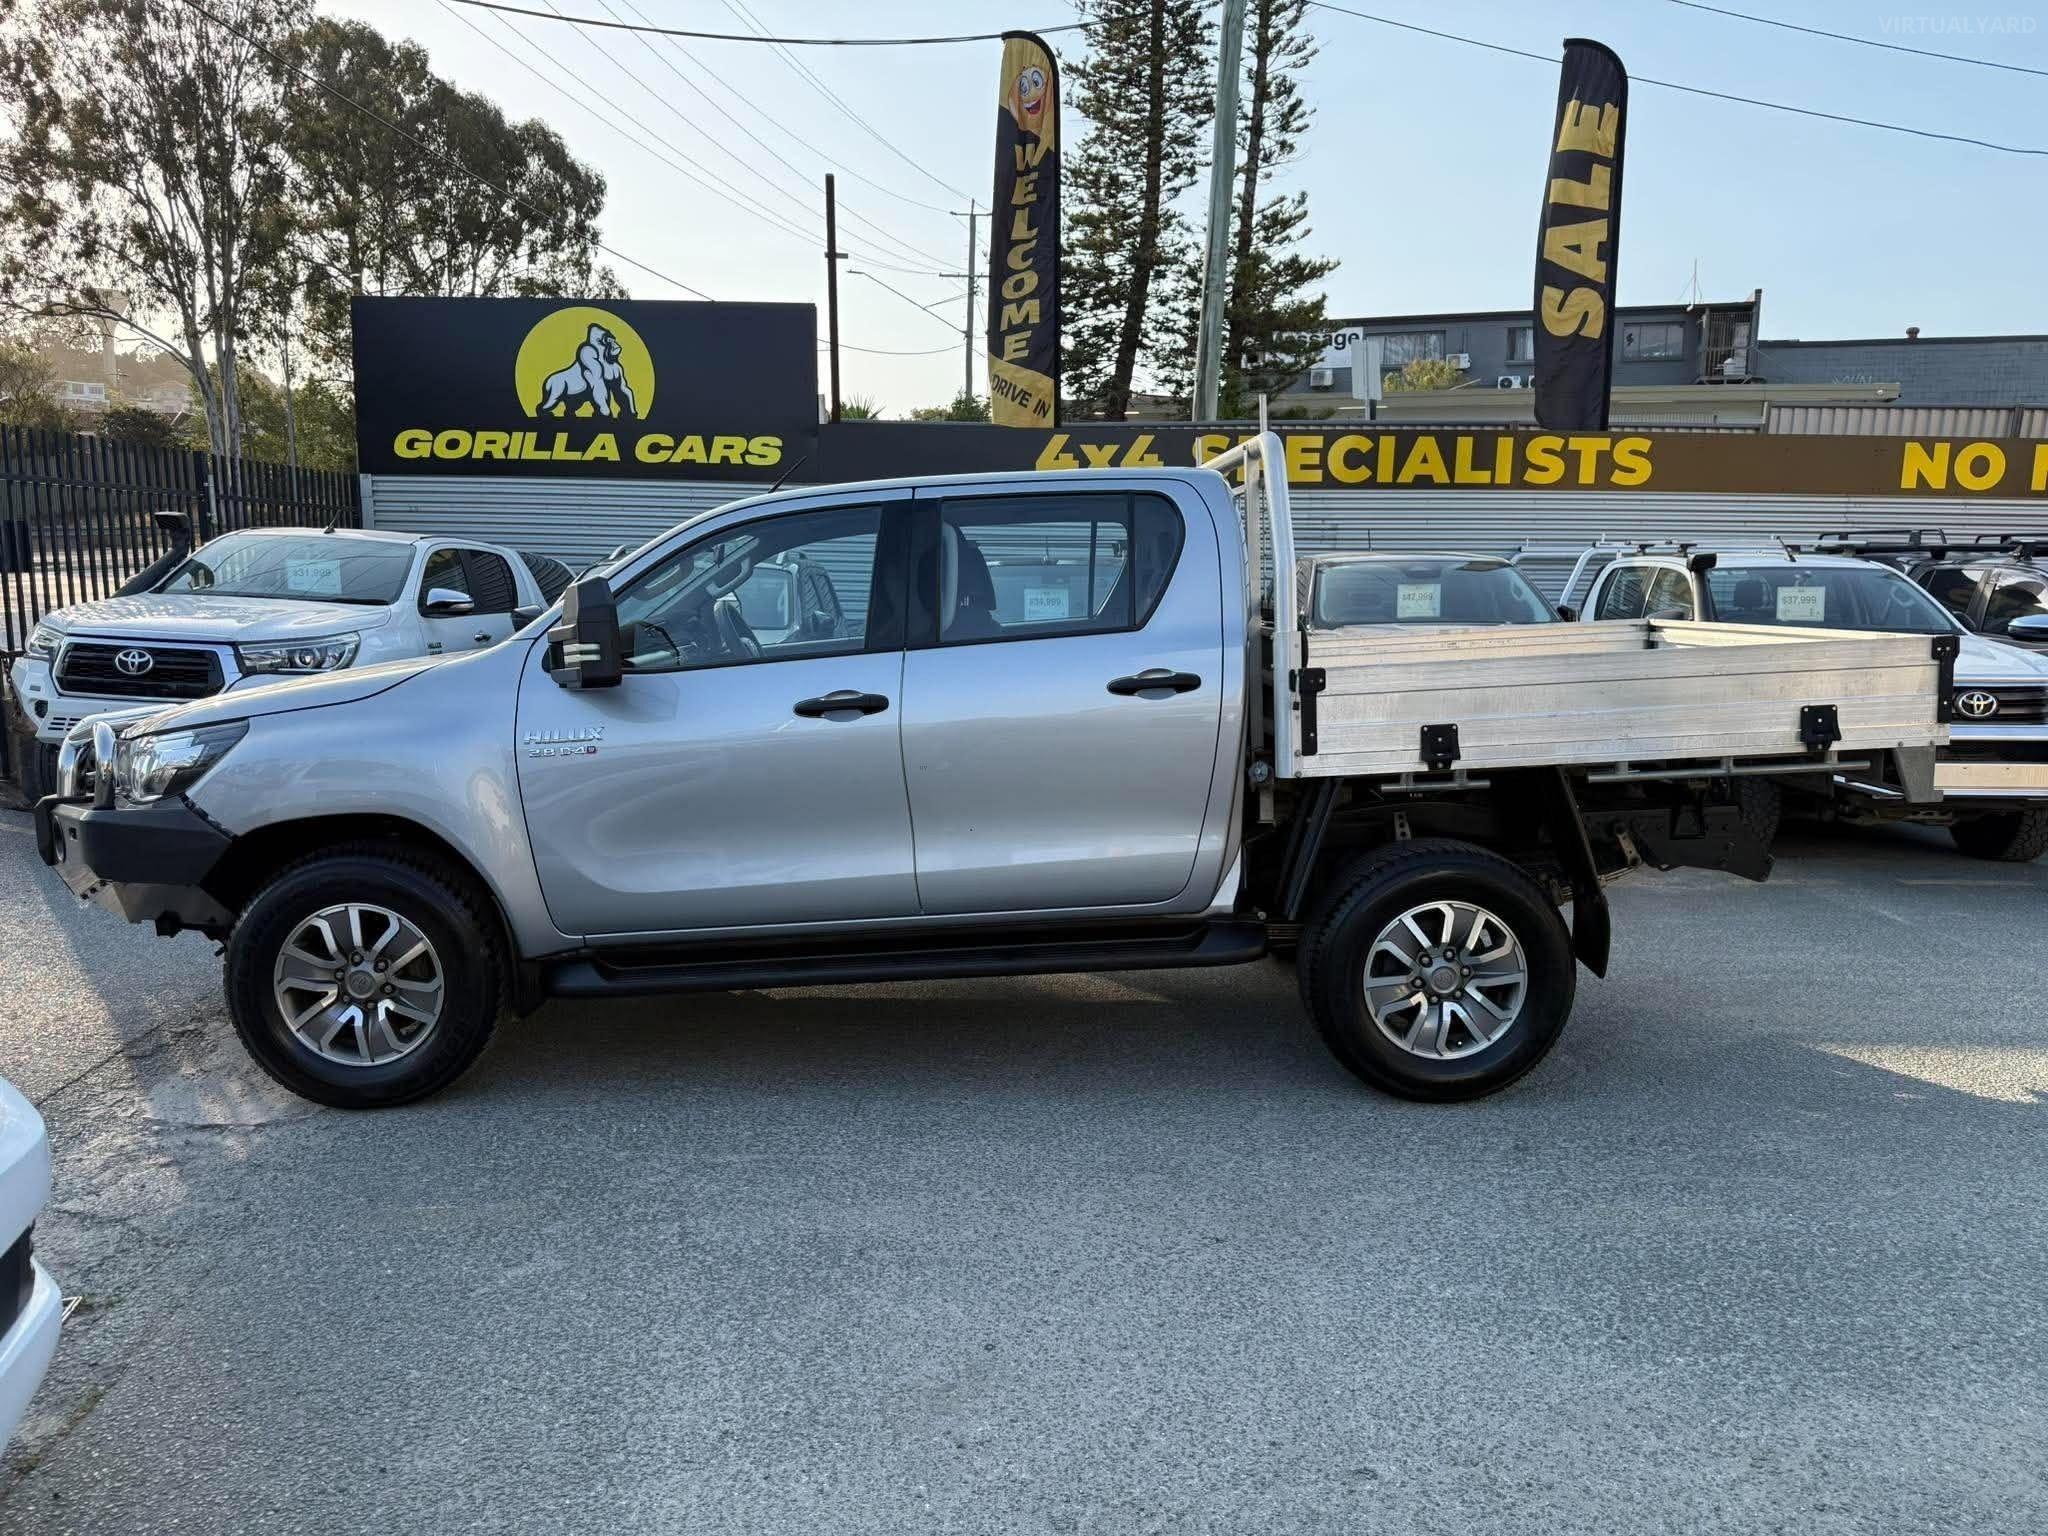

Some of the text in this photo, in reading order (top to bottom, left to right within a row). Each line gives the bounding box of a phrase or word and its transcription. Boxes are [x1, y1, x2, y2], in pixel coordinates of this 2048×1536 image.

[1542, 98, 1619, 339] SALE
[1000, 143, 1053, 361] WELCOME
[992, 374, 1051, 418] DRIVE IN
[393, 429, 783, 466] GORILLA CARS
[1036, 434, 1164, 470] 4x4
[1901, 442, 2006, 491] NO
[524, 727, 604, 744] HILUX
